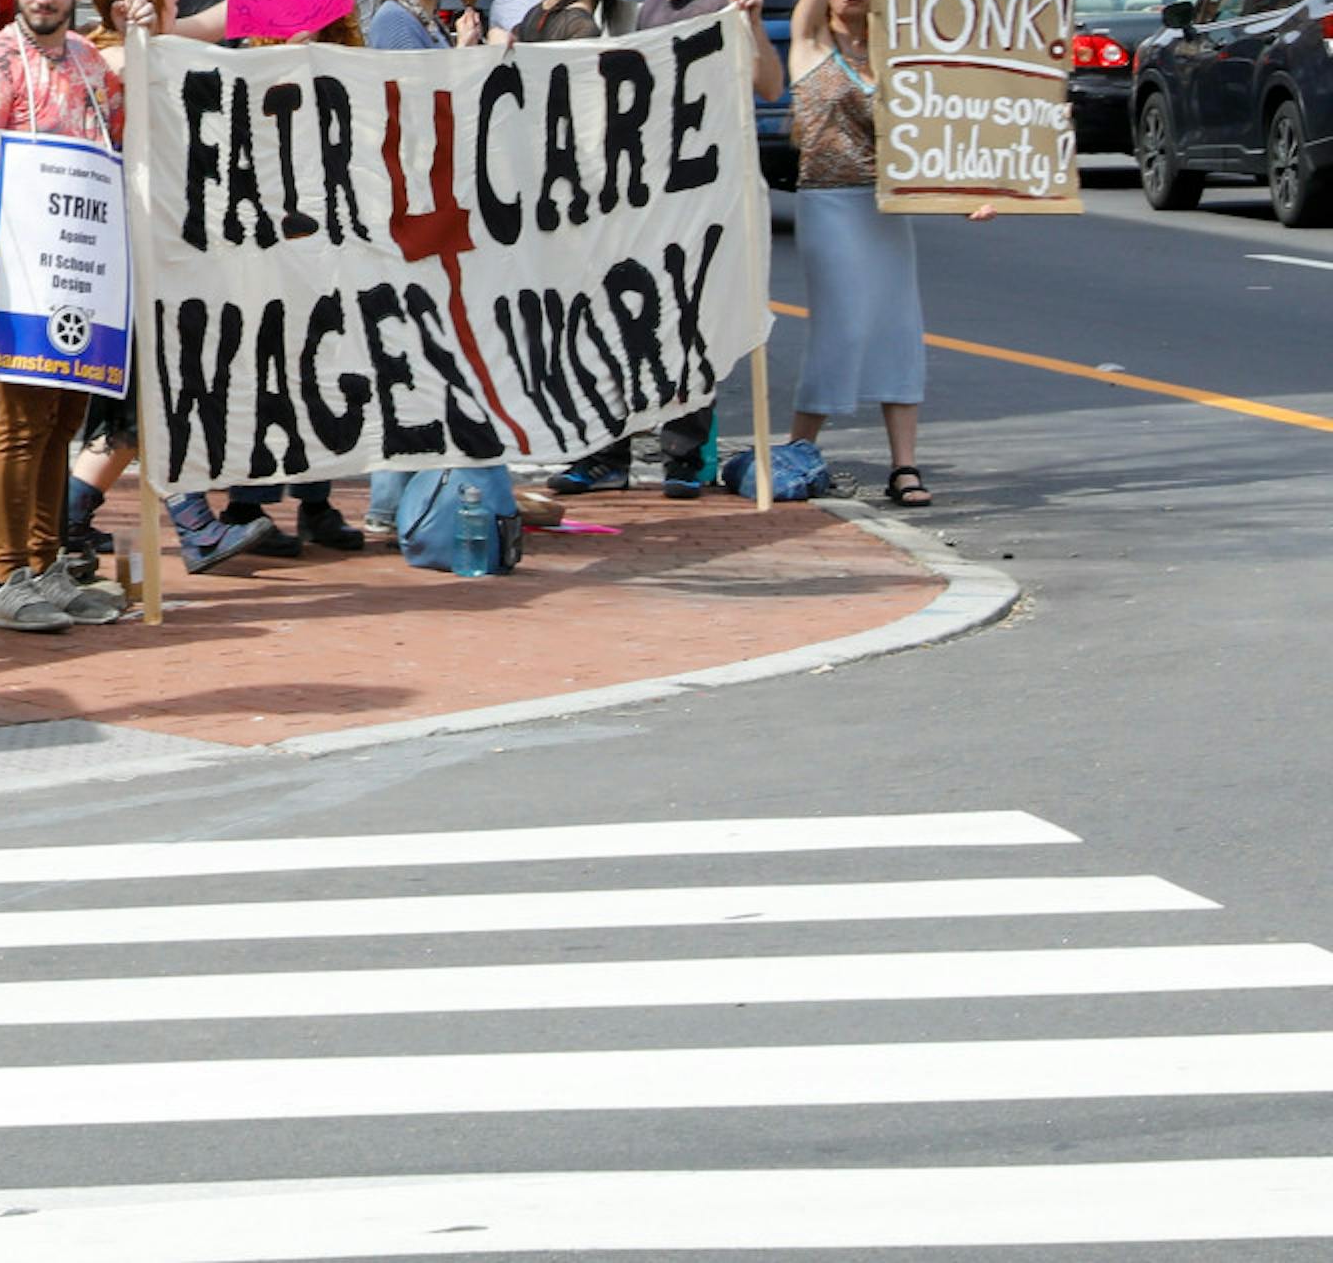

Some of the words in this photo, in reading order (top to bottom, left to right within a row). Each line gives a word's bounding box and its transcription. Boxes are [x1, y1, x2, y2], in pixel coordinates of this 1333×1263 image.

[888, 70, 988, 119] Show
[885, 123, 1077, 197] Solidarity!
[48, 192, 108, 224] STRIKE
[58, 228, 97, 246] Against
[182, 67, 371, 252] FAIR
[381, 79, 531, 456] 4
[476, 19, 725, 246] CARE
[40, 252, 53, 267] RI
[55, 254, 96, 275] School
[97, 262, 107, 276] of
[51, 274, 93, 294] Design
[154, 286, 505, 483] WAGES
[494, 223, 723, 455] WORK
[74, 360, 106, 380] Local
